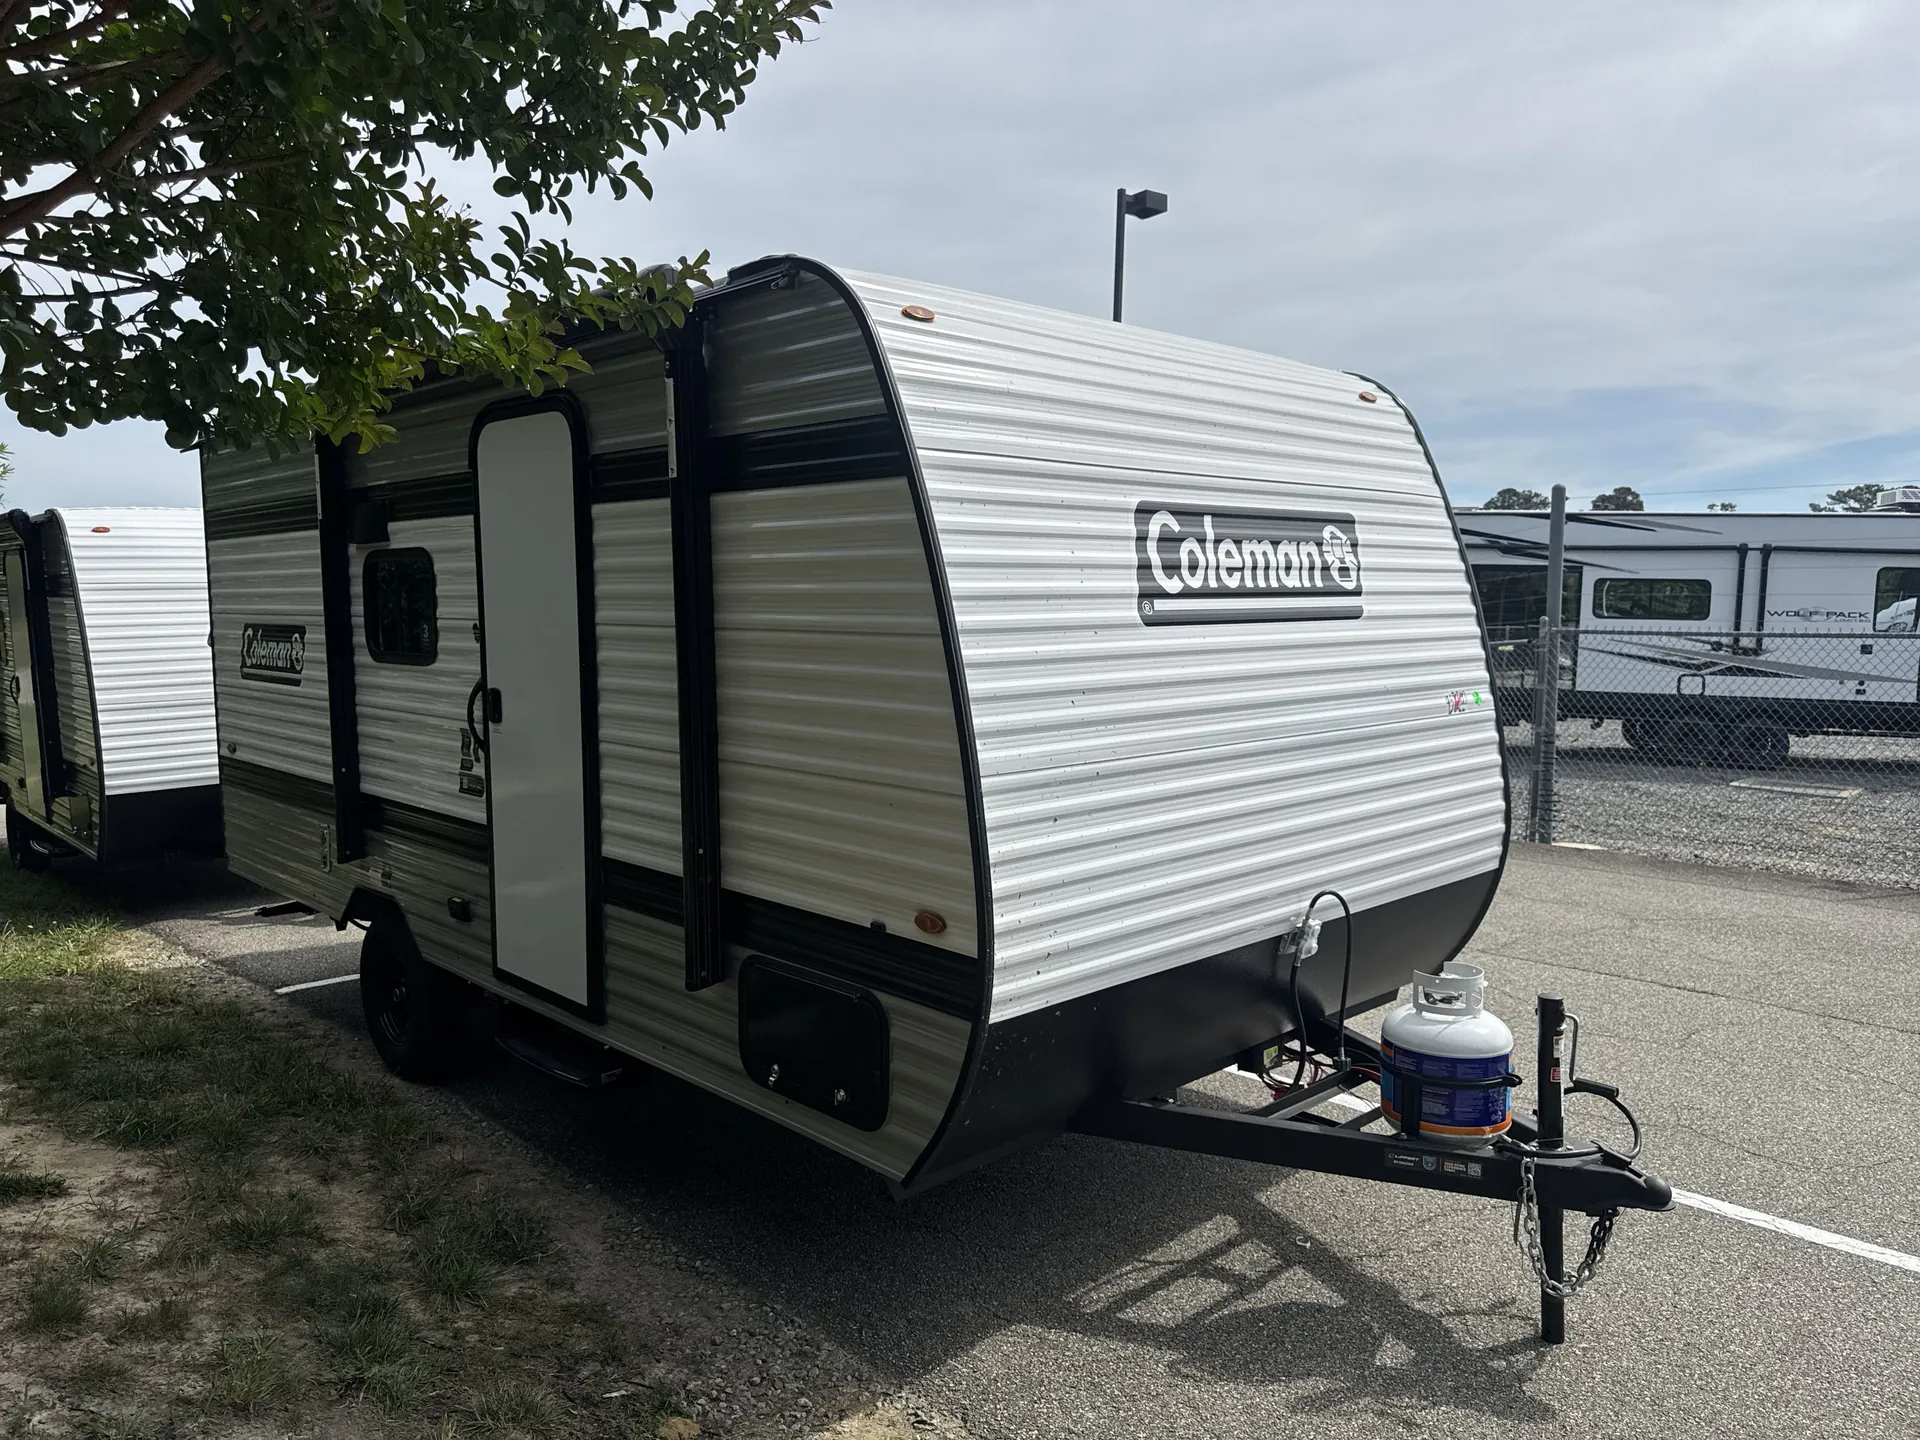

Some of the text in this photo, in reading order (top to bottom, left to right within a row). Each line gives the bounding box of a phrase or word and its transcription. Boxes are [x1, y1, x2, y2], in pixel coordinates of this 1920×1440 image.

[1146, 510, 1324, 594] Coleman
[1766, 609, 1870, 619] WOLF PACK
[243, 627, 292, 669] Coleman
